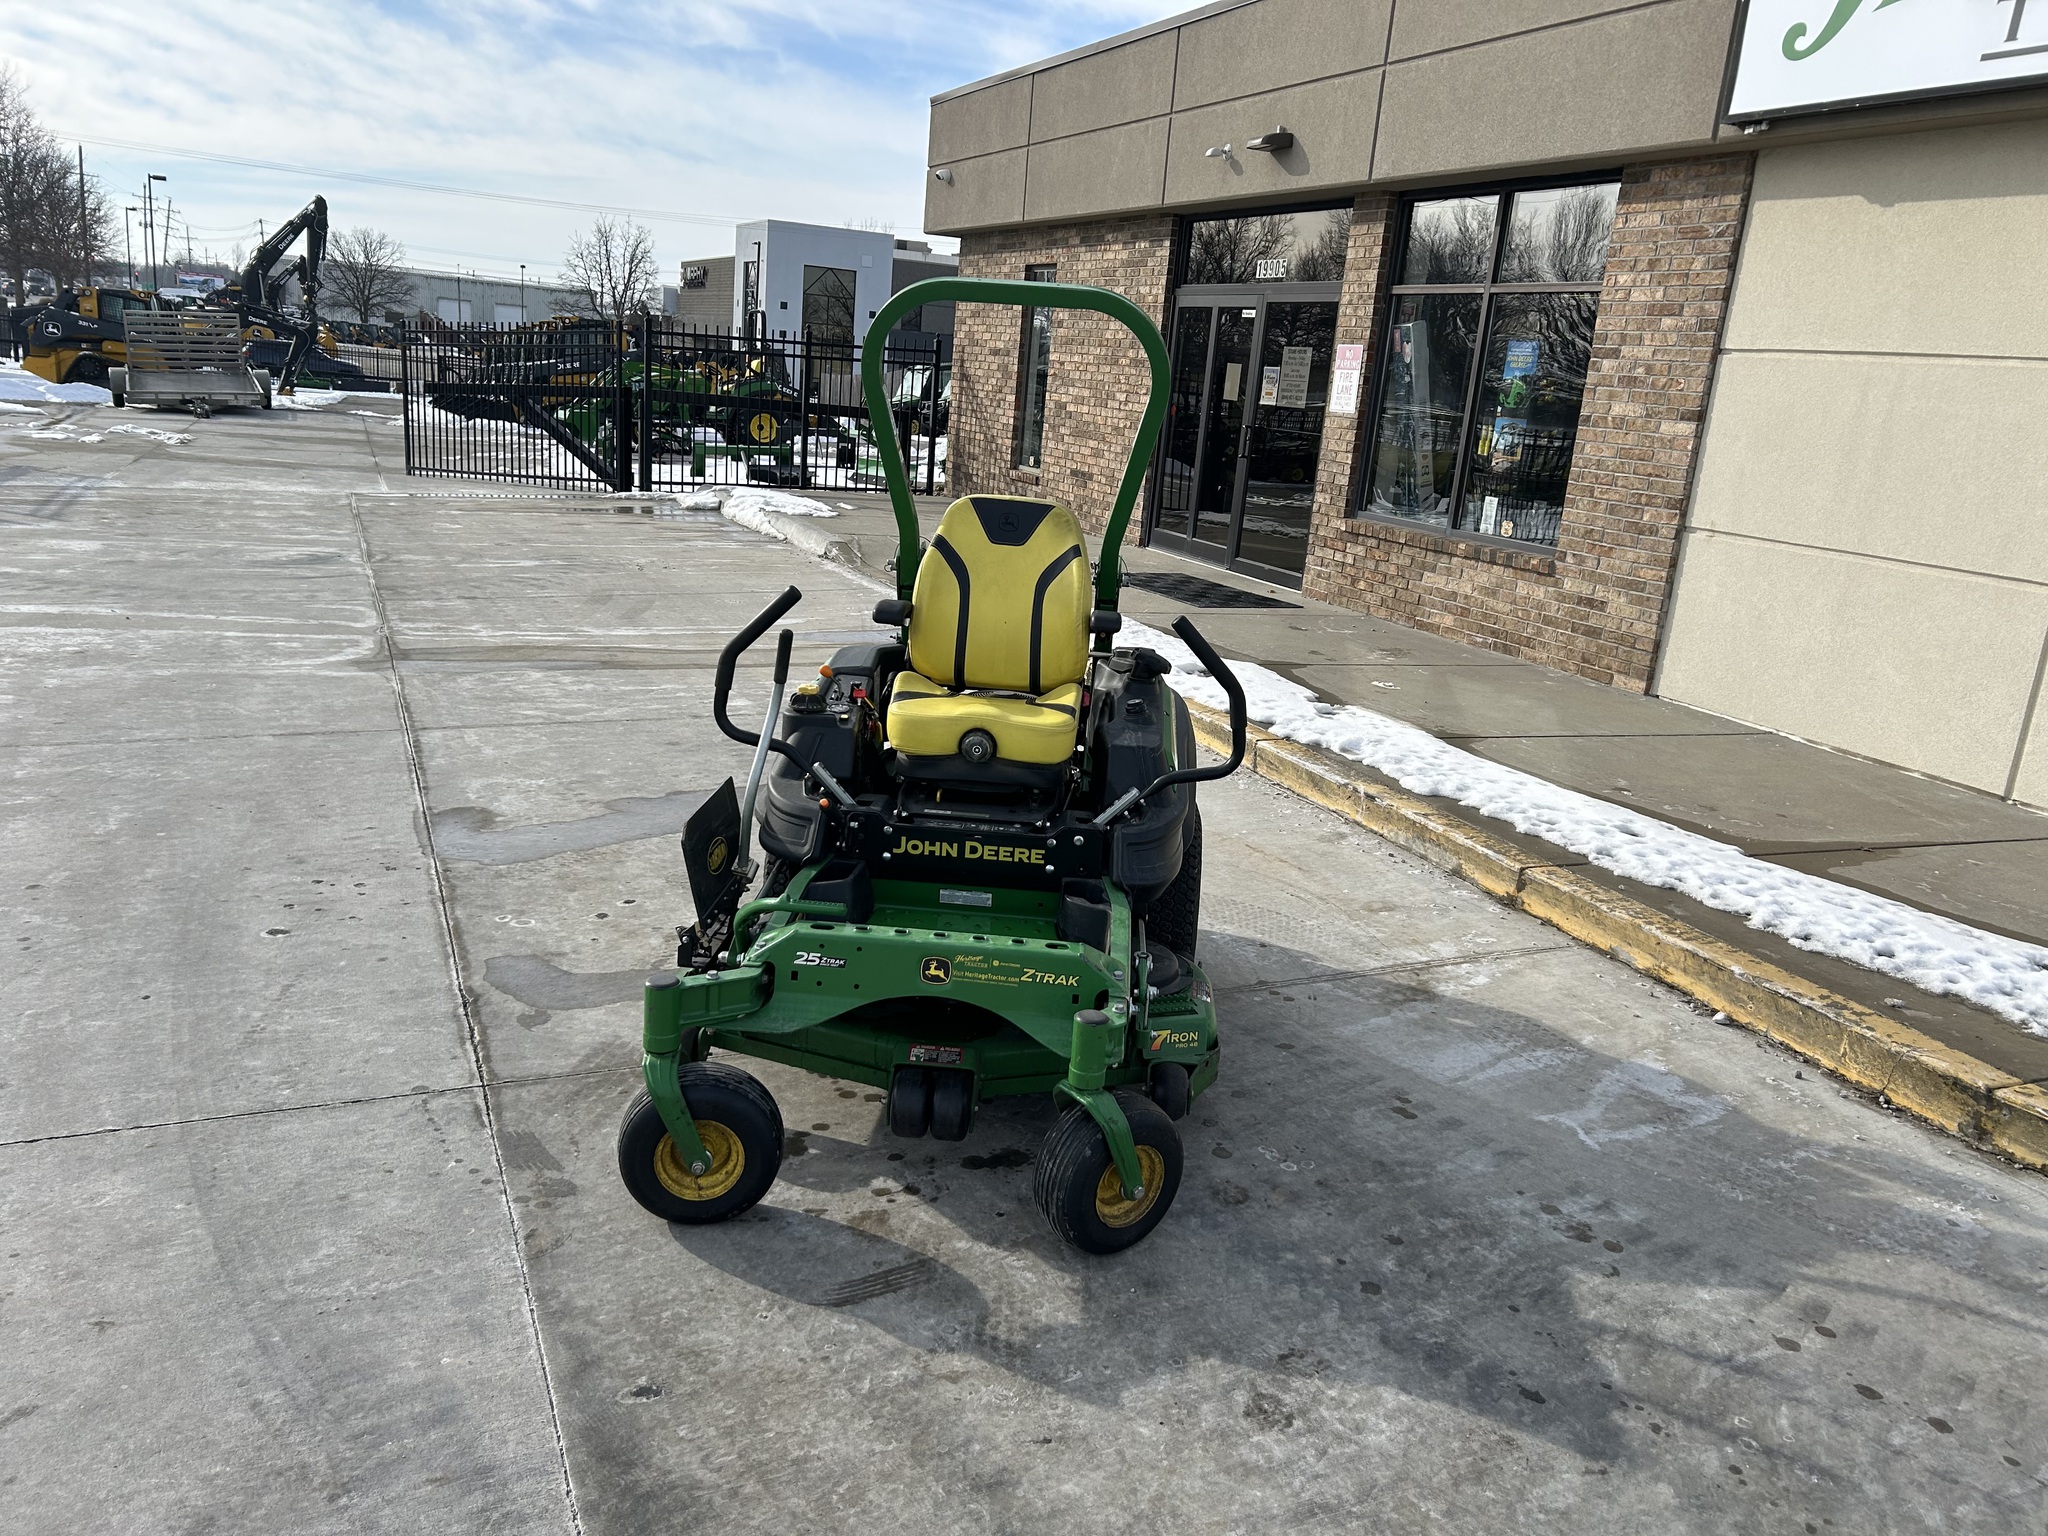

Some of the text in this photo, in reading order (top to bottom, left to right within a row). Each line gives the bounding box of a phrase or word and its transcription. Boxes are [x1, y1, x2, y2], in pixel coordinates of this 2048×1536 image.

[278, 232, 295, 250] DEERE
[1258, 260, 1287, 277] 19905
[248, 315, 268, 325] DEERE
[1345, 349, 1354, 360] NO
[1337, 359, 1361, 370] PARKING
[1339, 372, 1353, 383] FIRE
[1337, 384, 1353, 395] LANE
[893, 836, 1045, 864] JOHN DEERE
[793, 951, 822, 966] 25
[965, 971, 1020, 983] HeritageTractor.com
[1020, 968, 1081, 987] ZTRAK
